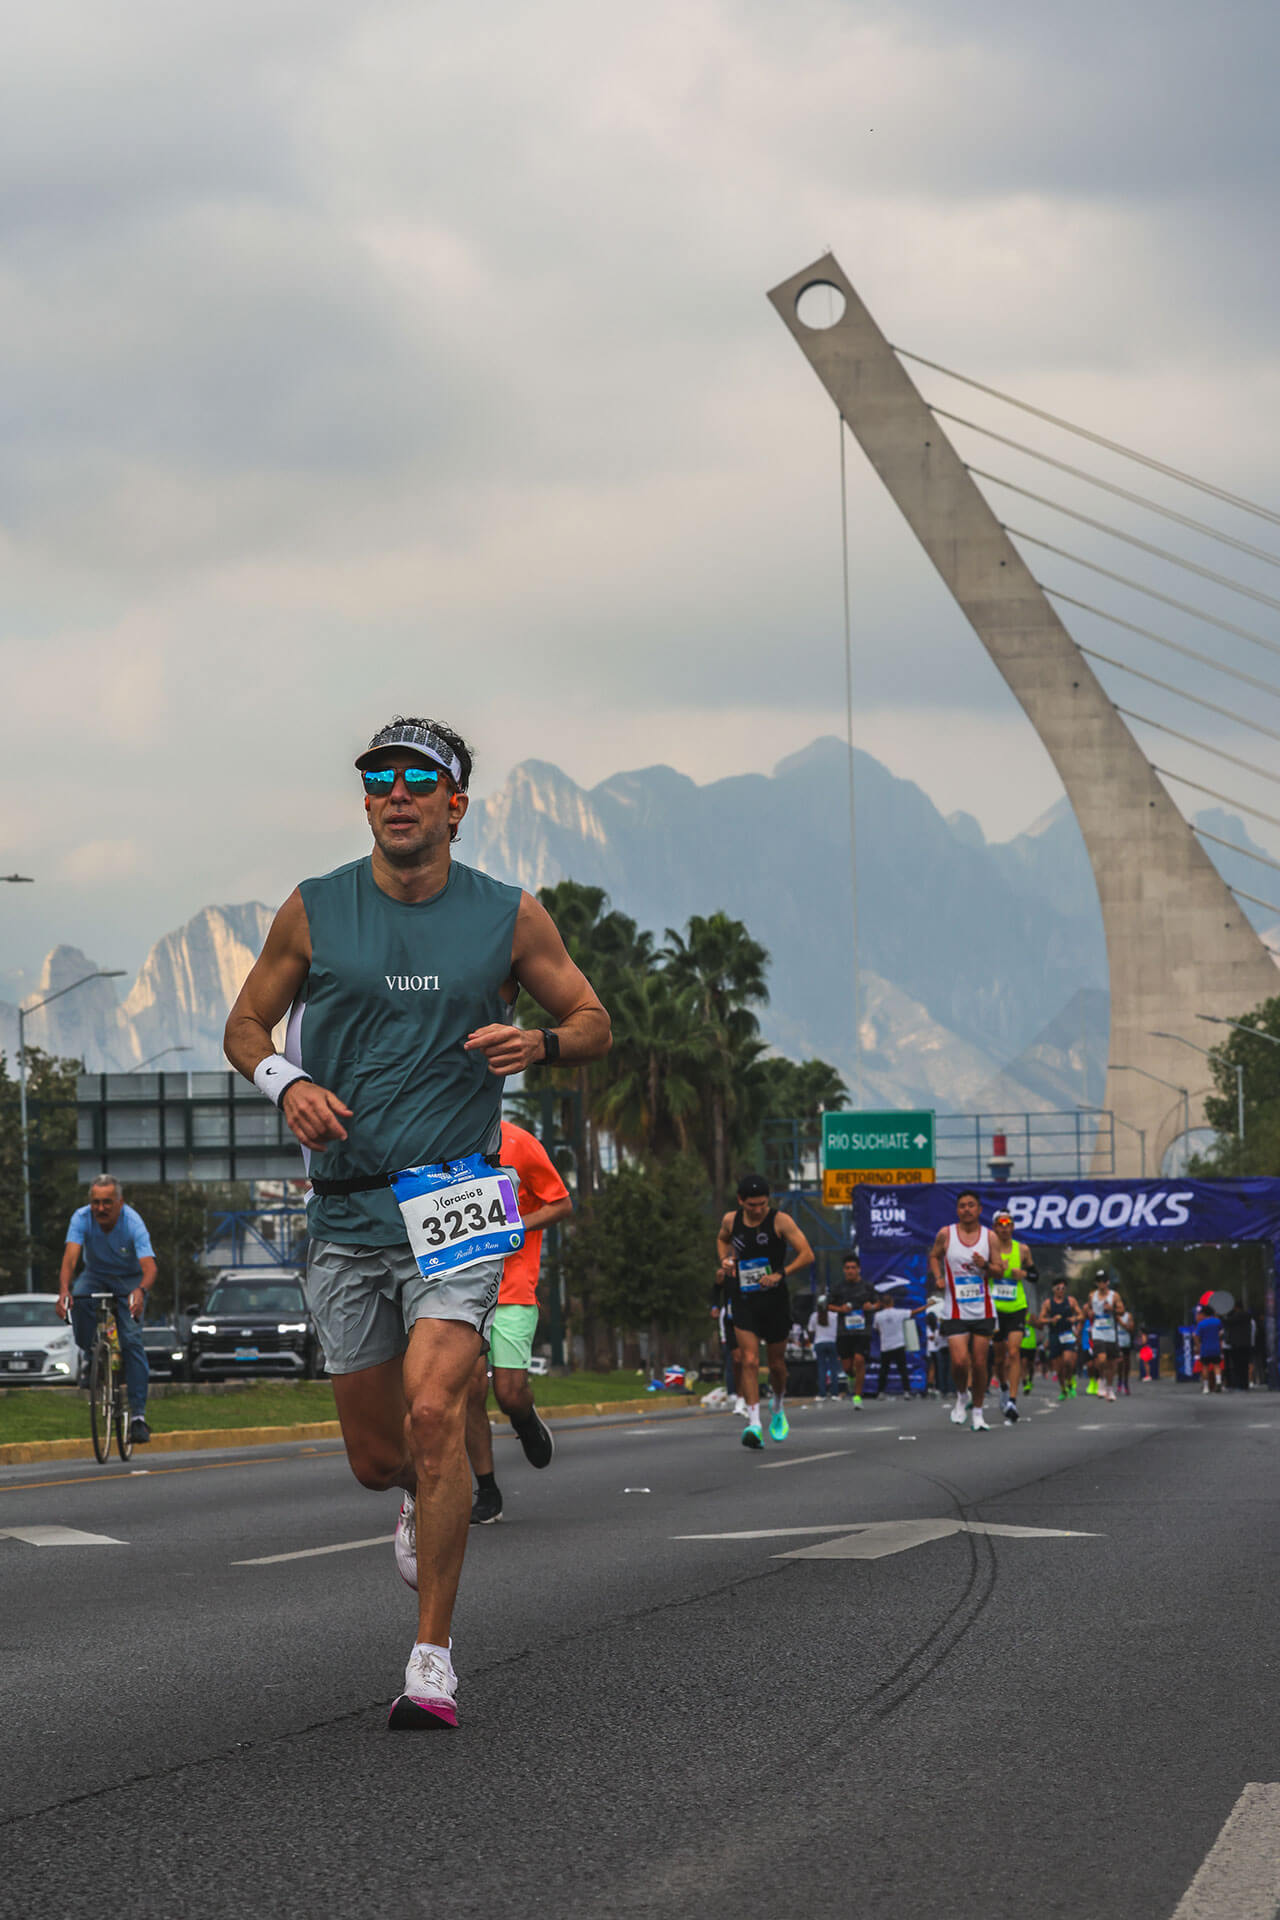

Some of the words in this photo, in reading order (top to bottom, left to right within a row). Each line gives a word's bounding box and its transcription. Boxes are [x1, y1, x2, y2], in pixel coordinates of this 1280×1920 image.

[384, 975, 440, 991] vuori
[852, 1133, 910, 1150] SUCHIATE
[836, 1171, 893, 1184] RETORNO
[896, 1171, 922, 1184] POR
[474, 1188, 484, 1197] B
[870, 1208, 906, 1222] RUN
[1007, 1192, 1194, 1229] BROOKS
[422, 1198, 507, 1246] 3234
